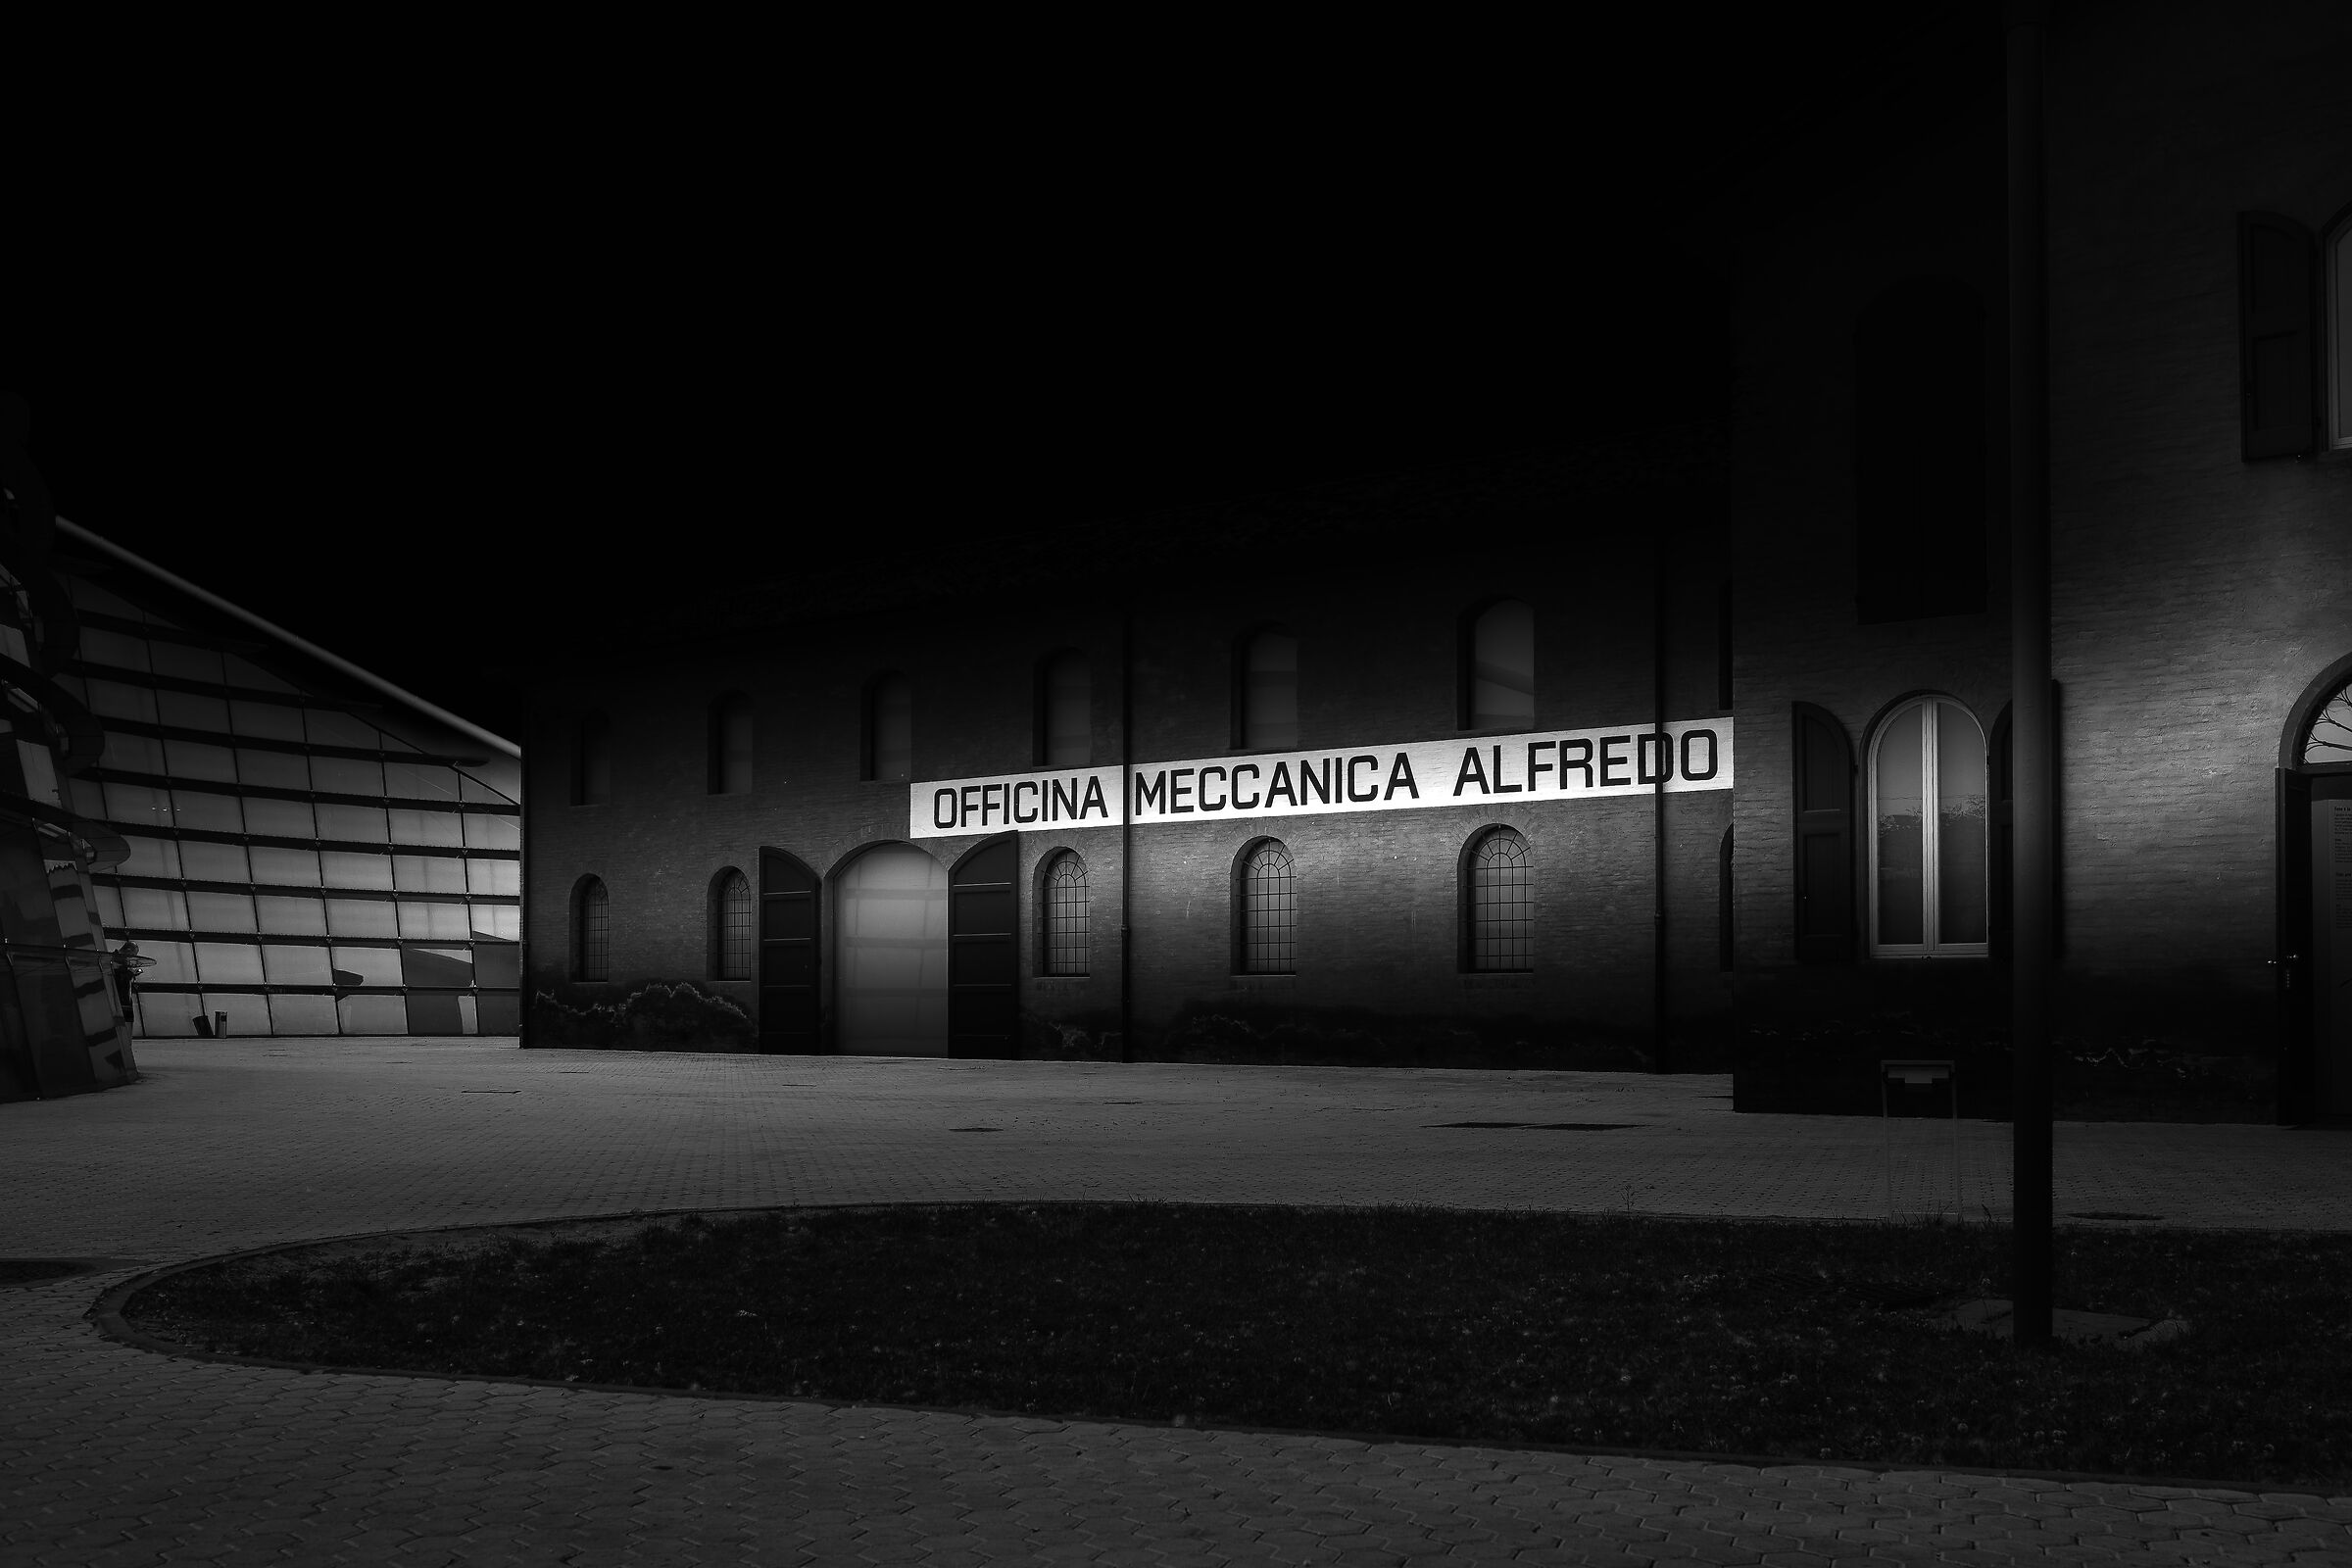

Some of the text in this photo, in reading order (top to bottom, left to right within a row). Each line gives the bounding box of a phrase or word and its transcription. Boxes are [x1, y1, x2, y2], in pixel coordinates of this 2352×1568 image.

[934, 729, 1719, 829] OFFICINA MECCANICA ALFREDO
